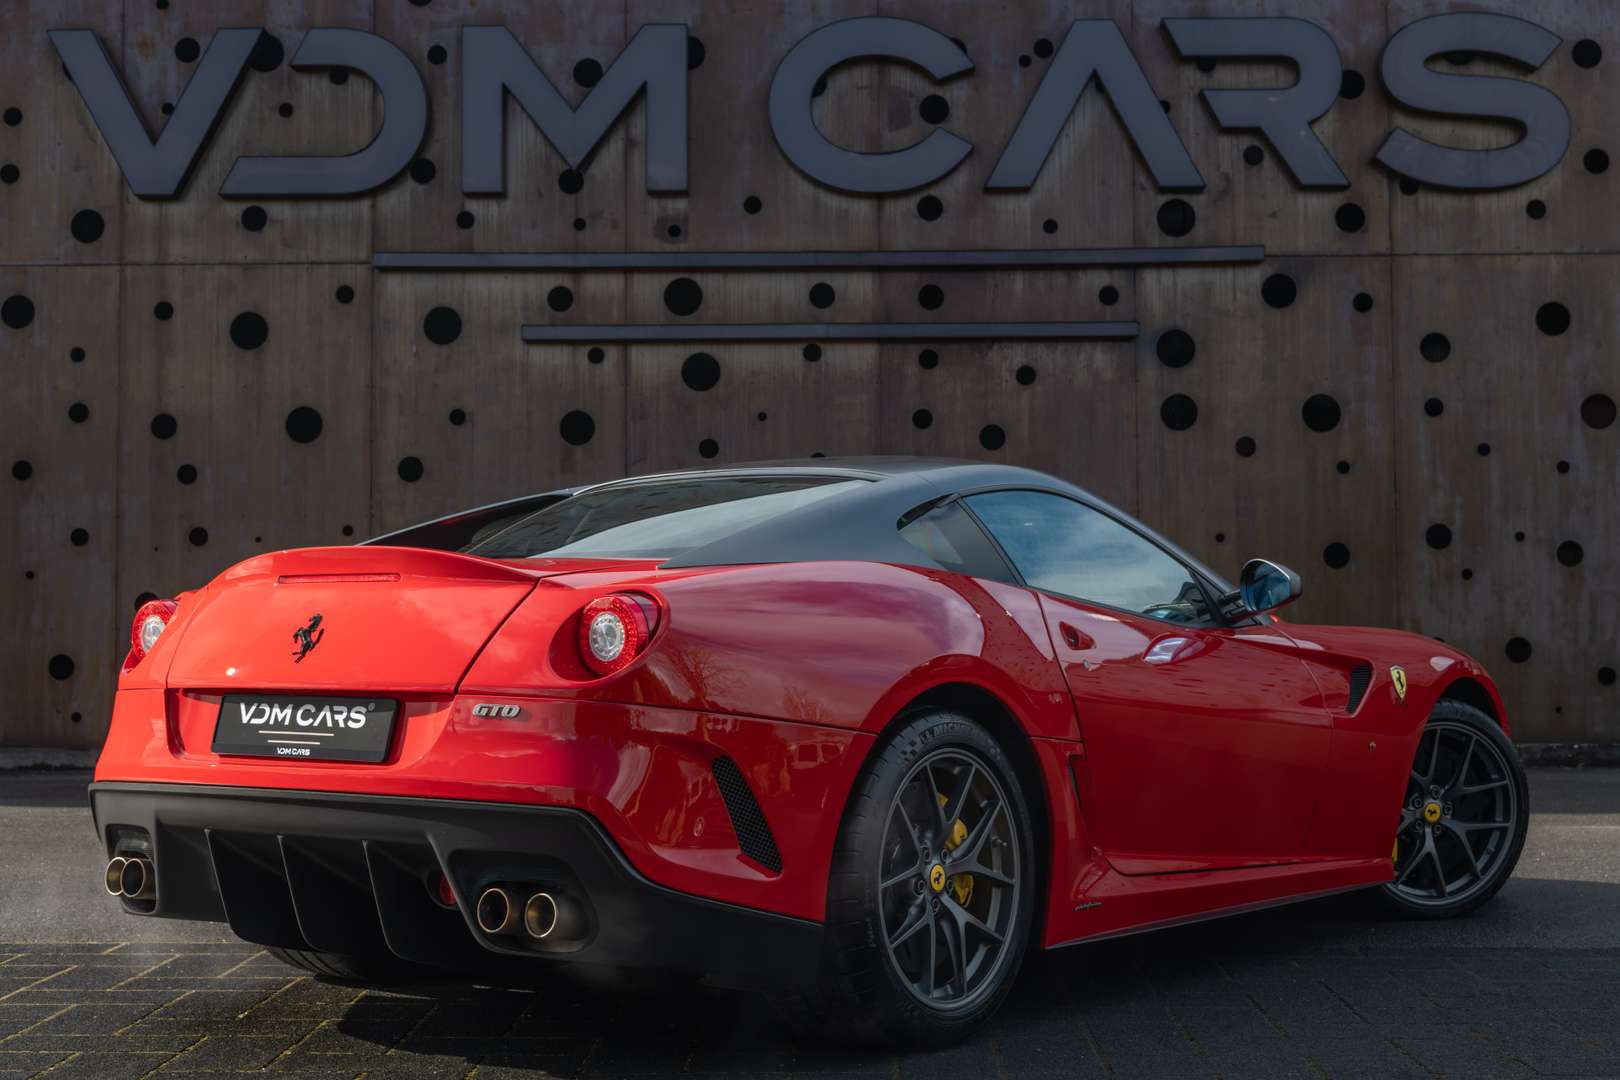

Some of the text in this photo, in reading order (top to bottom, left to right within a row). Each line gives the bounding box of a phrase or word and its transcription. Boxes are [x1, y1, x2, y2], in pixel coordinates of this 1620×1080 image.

[47, 12, 1572, 200] VDM CARS
[240, 702, 293, 726] VDM
[472, 703, 520, 718] GTO
[276, 746, 311, 756] VDM CARS
